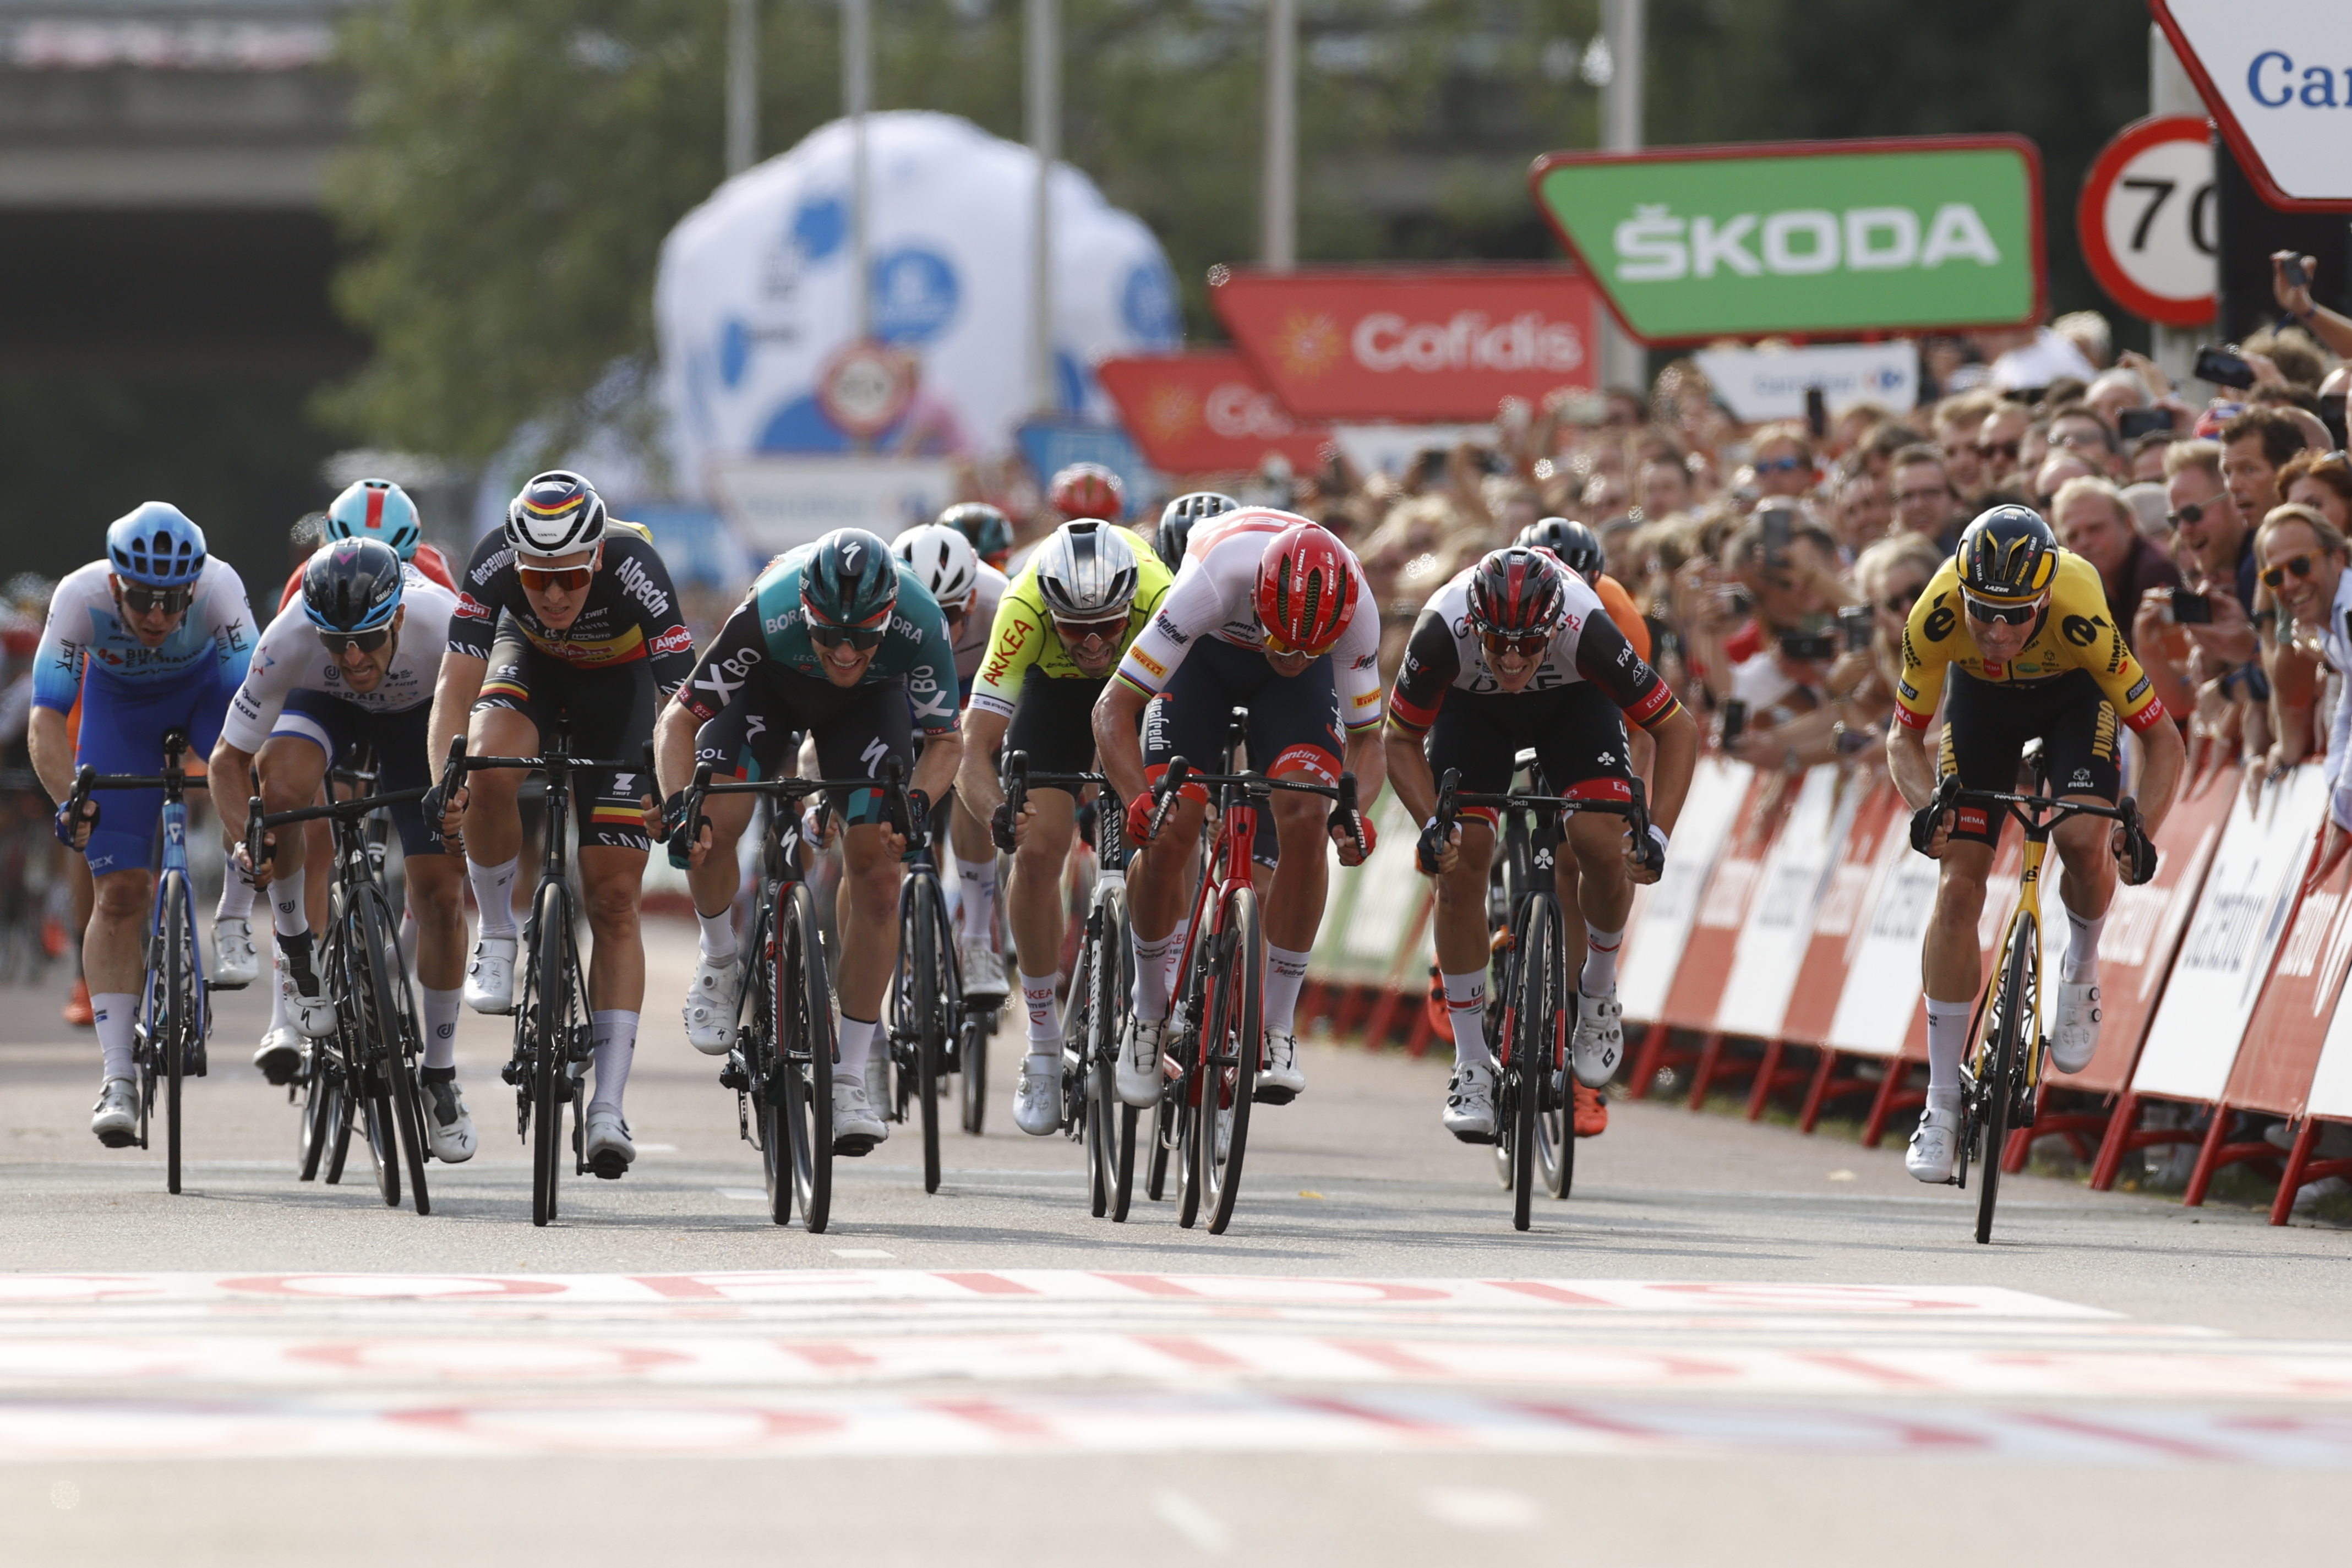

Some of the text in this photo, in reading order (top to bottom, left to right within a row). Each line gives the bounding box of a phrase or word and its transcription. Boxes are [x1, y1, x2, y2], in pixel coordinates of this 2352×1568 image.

[2247, 50, 2352, 108] Ca
[1613, 204, 2001, 281] ŠKODA
[1350, 310, 1584, 373] Cofidis
[1297, 548, 1306, 572] TREK
[2015, 561, 2029, 586] JUMBO
[614, 556, 669, 619] Alpecin
[1544, 582, 1562, 620] MET
[1985, 584, 2010, 593] LAZER
[585, 607, 608, 619] ZWIFT
[890, 614, 923, 645] ORA
[983, 619, 1034, 687] ARKEA
[1469, 675, 1562, 692] UE
[1940, 722, 1960, 778] JUMB
[2092, 700, 2115, 762] JUMBO
[695, 748, 727, 761] COL
[1351, 808, 1366, 849] SRAM
[1961, 816, 1985, 826] HEMA
